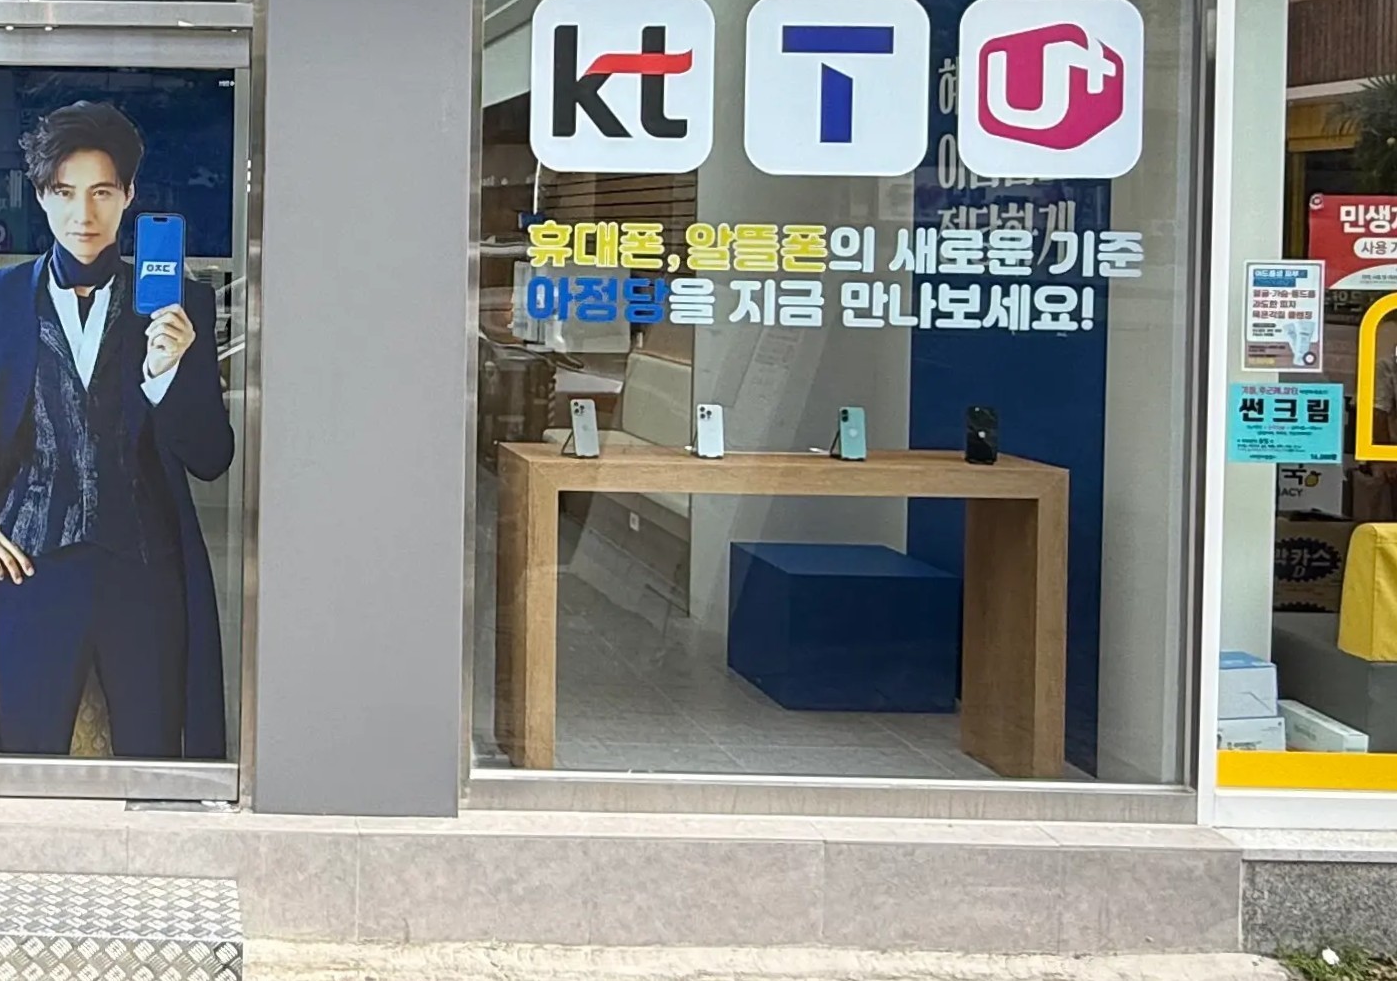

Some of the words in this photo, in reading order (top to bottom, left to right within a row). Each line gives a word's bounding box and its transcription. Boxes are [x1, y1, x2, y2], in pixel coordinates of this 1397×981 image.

[552, 25, 693, 138] kt
[781, 26, 894, 143] T
[1340, 204, 1397, 234] 민생
[527, 221, 876, 273] 휴대폰,알뜰폰의
[889, 225, 1035, 276] 새로운
[1049, 230, 1144, 277] 기준
[1361, 241, 1387, 255] 사용
[526, 275, 716, 326] 아정당을
[730, 278, 825, 328] 지금
[840, 281, 1095, 331] 만나보세요!
